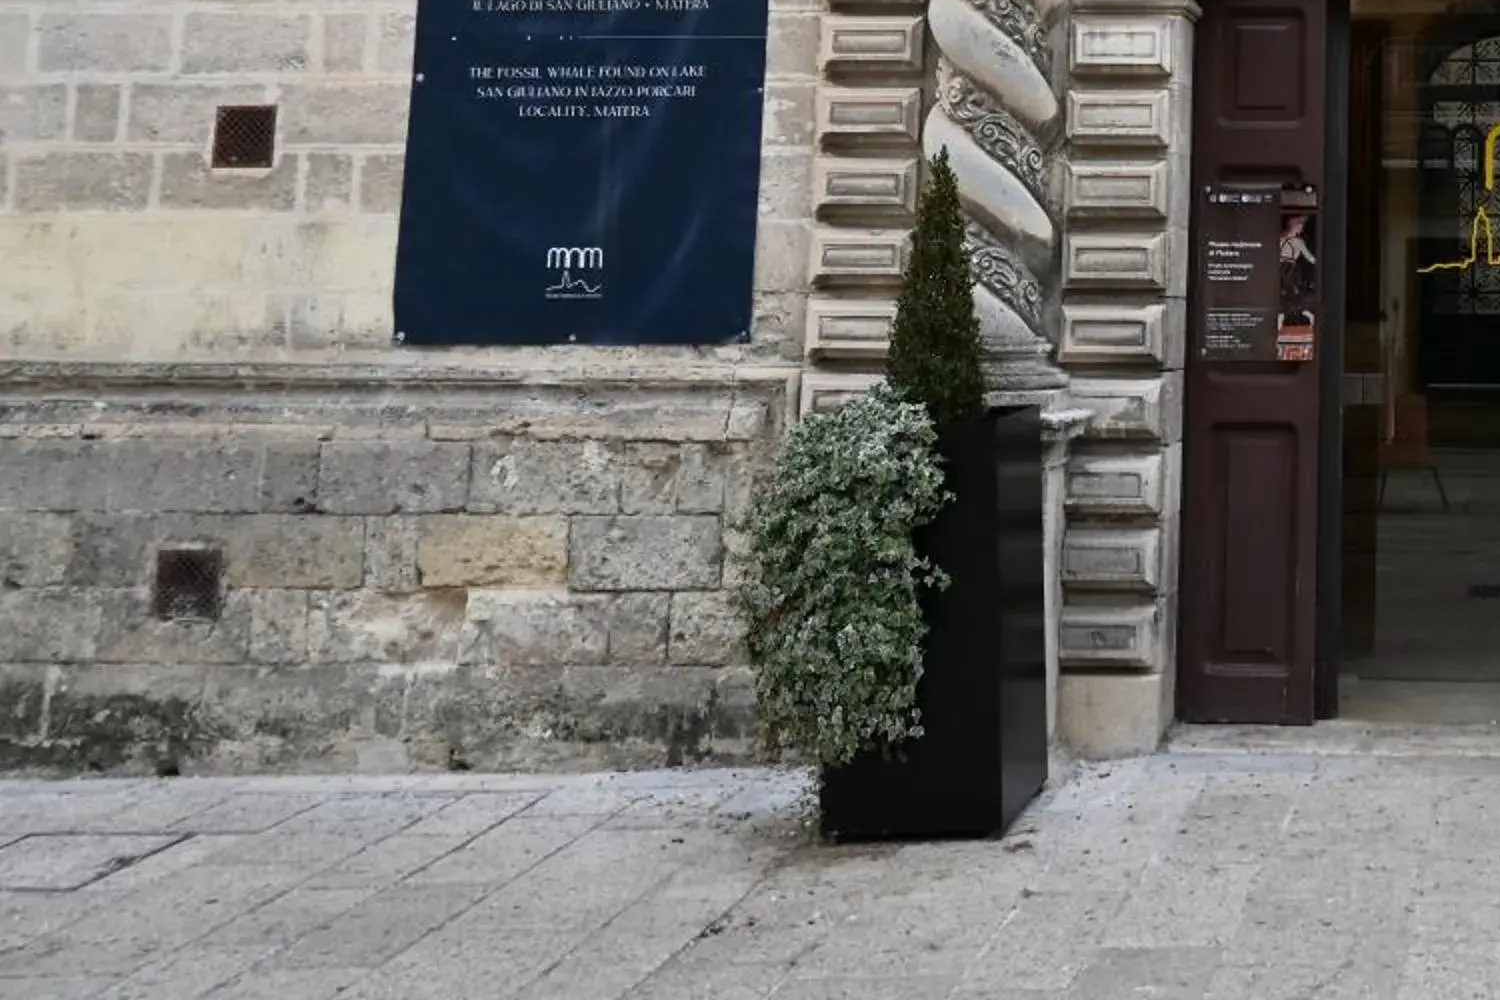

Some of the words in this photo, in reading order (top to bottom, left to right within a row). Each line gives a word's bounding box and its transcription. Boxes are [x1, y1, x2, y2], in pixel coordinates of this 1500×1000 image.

[487, 0, 526, 12] LAGO
[529, 0, 543, 11] DI
[546, 0, 573, 11] SAN
[469, 66, 494, 79] THE
[497, 66, 543, 79] FOSSIL
[547, 66, 595, 79] WHALE
[599, 65, 645, 78] FOUND
[649, 65, 669, 78] ON
[671, 65, 705, 77] LAKE
[476, 85, 503, 98] SAN
[507, 85, 571, 98] GIULIANO
[575, 85, 588, 97] IN
[637, 85, 696, 97] PORCARI
[594, 105, 651, 118] MATERA
